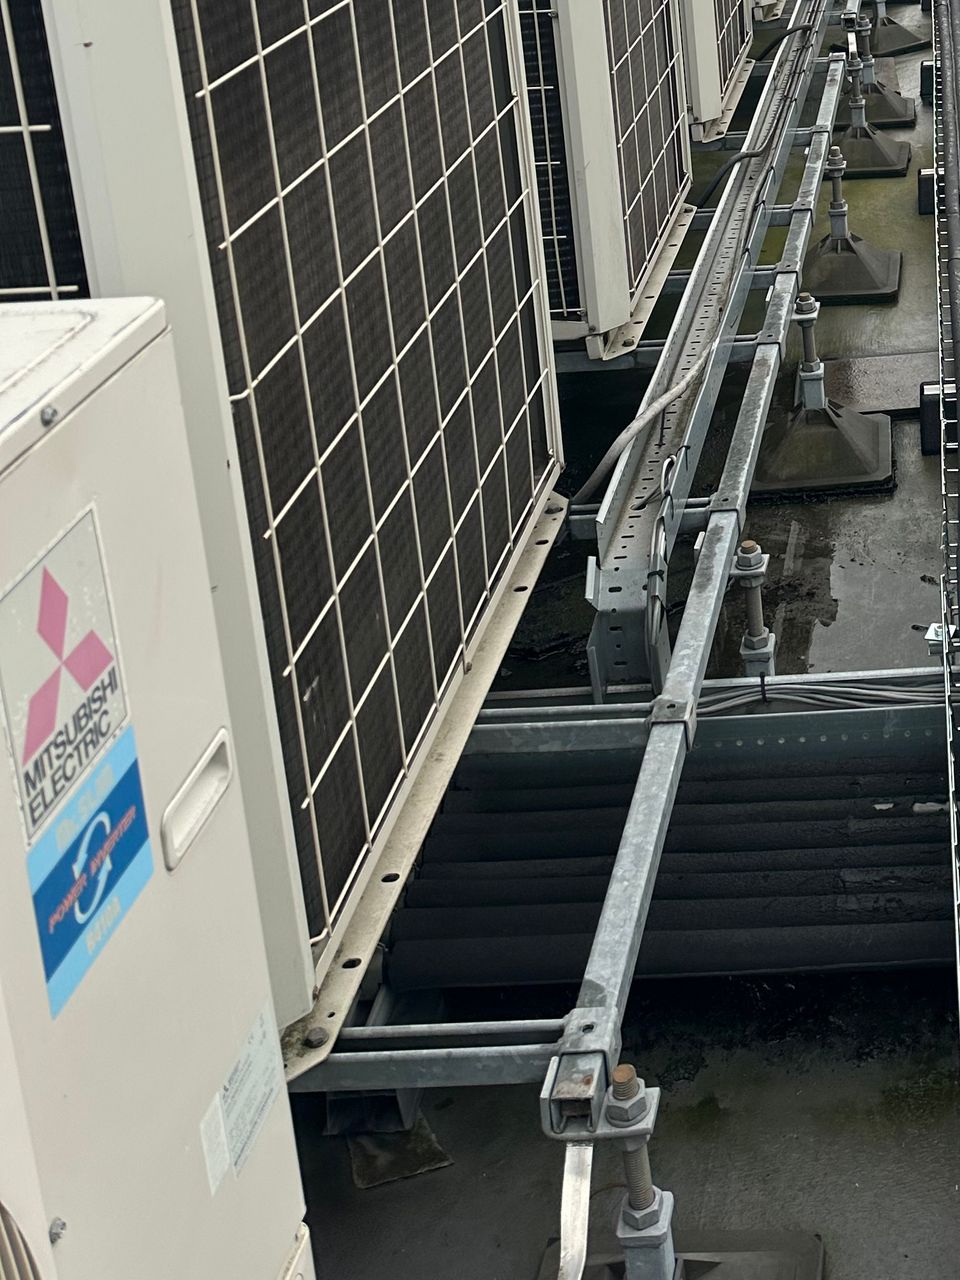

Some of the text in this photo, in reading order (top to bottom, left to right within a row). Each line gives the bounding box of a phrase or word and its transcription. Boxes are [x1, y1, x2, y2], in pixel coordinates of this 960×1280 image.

[23, 667, 118, 798] MITSUBISHI
[28, 709, 111, 828] ELECTRIC
[48, 873, 87, 935] POWER
[89, 804, 136, 877] INVERTER
